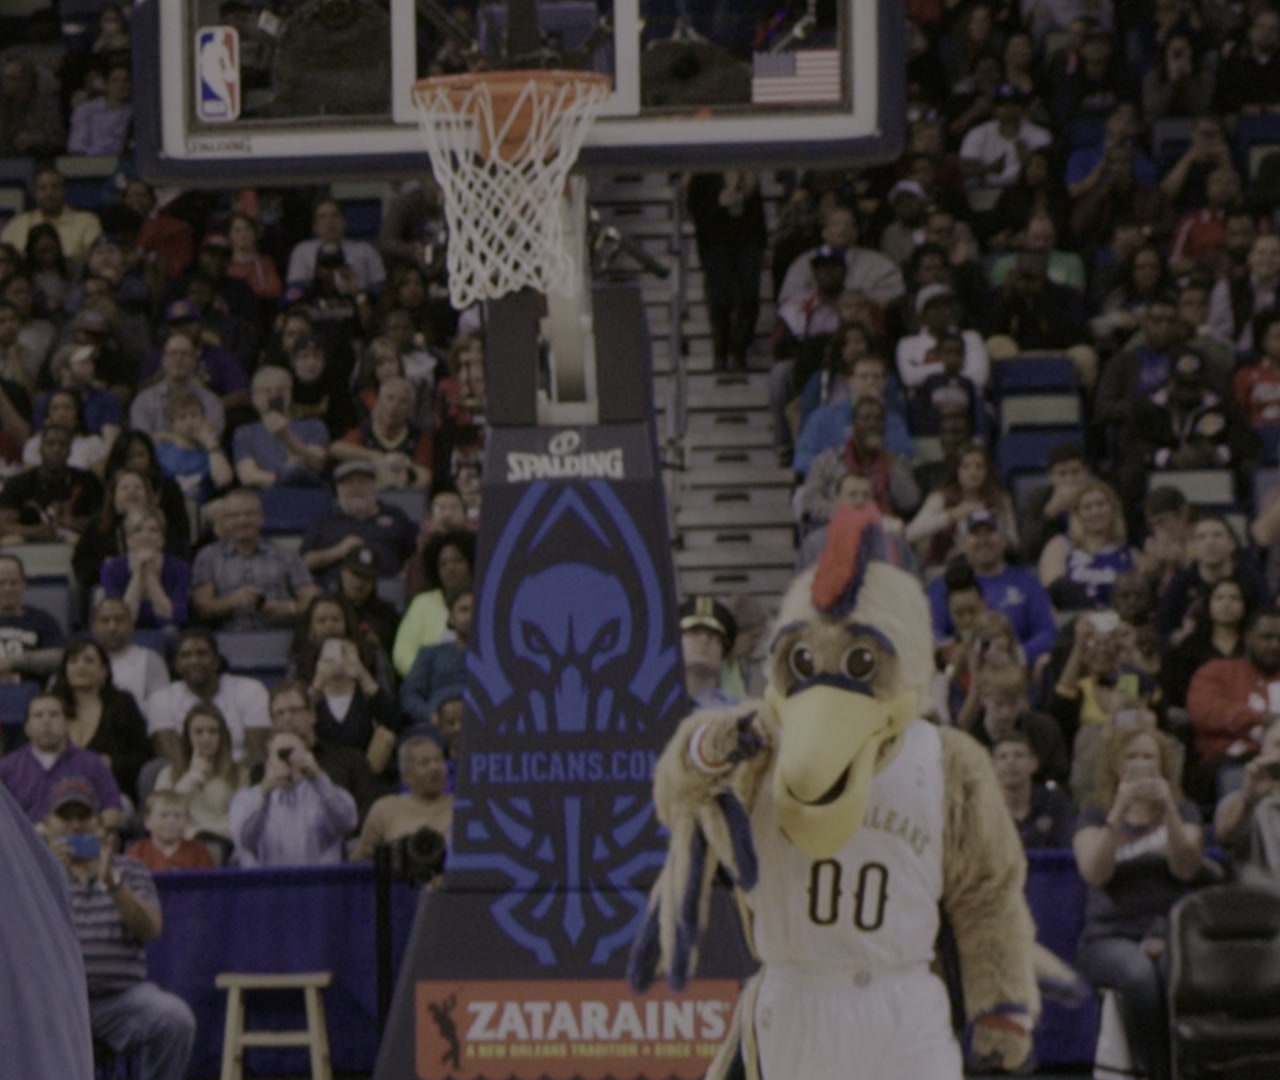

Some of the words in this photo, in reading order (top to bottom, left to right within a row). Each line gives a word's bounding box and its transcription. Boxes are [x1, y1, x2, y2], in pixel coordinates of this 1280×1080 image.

[506, 448, 626, 484] SPALDING
[862, 804, 931, 858] LEANS
[807, 857, 889, 932] 00
[465, 999, 726, 1042] ZATARAIN'S
